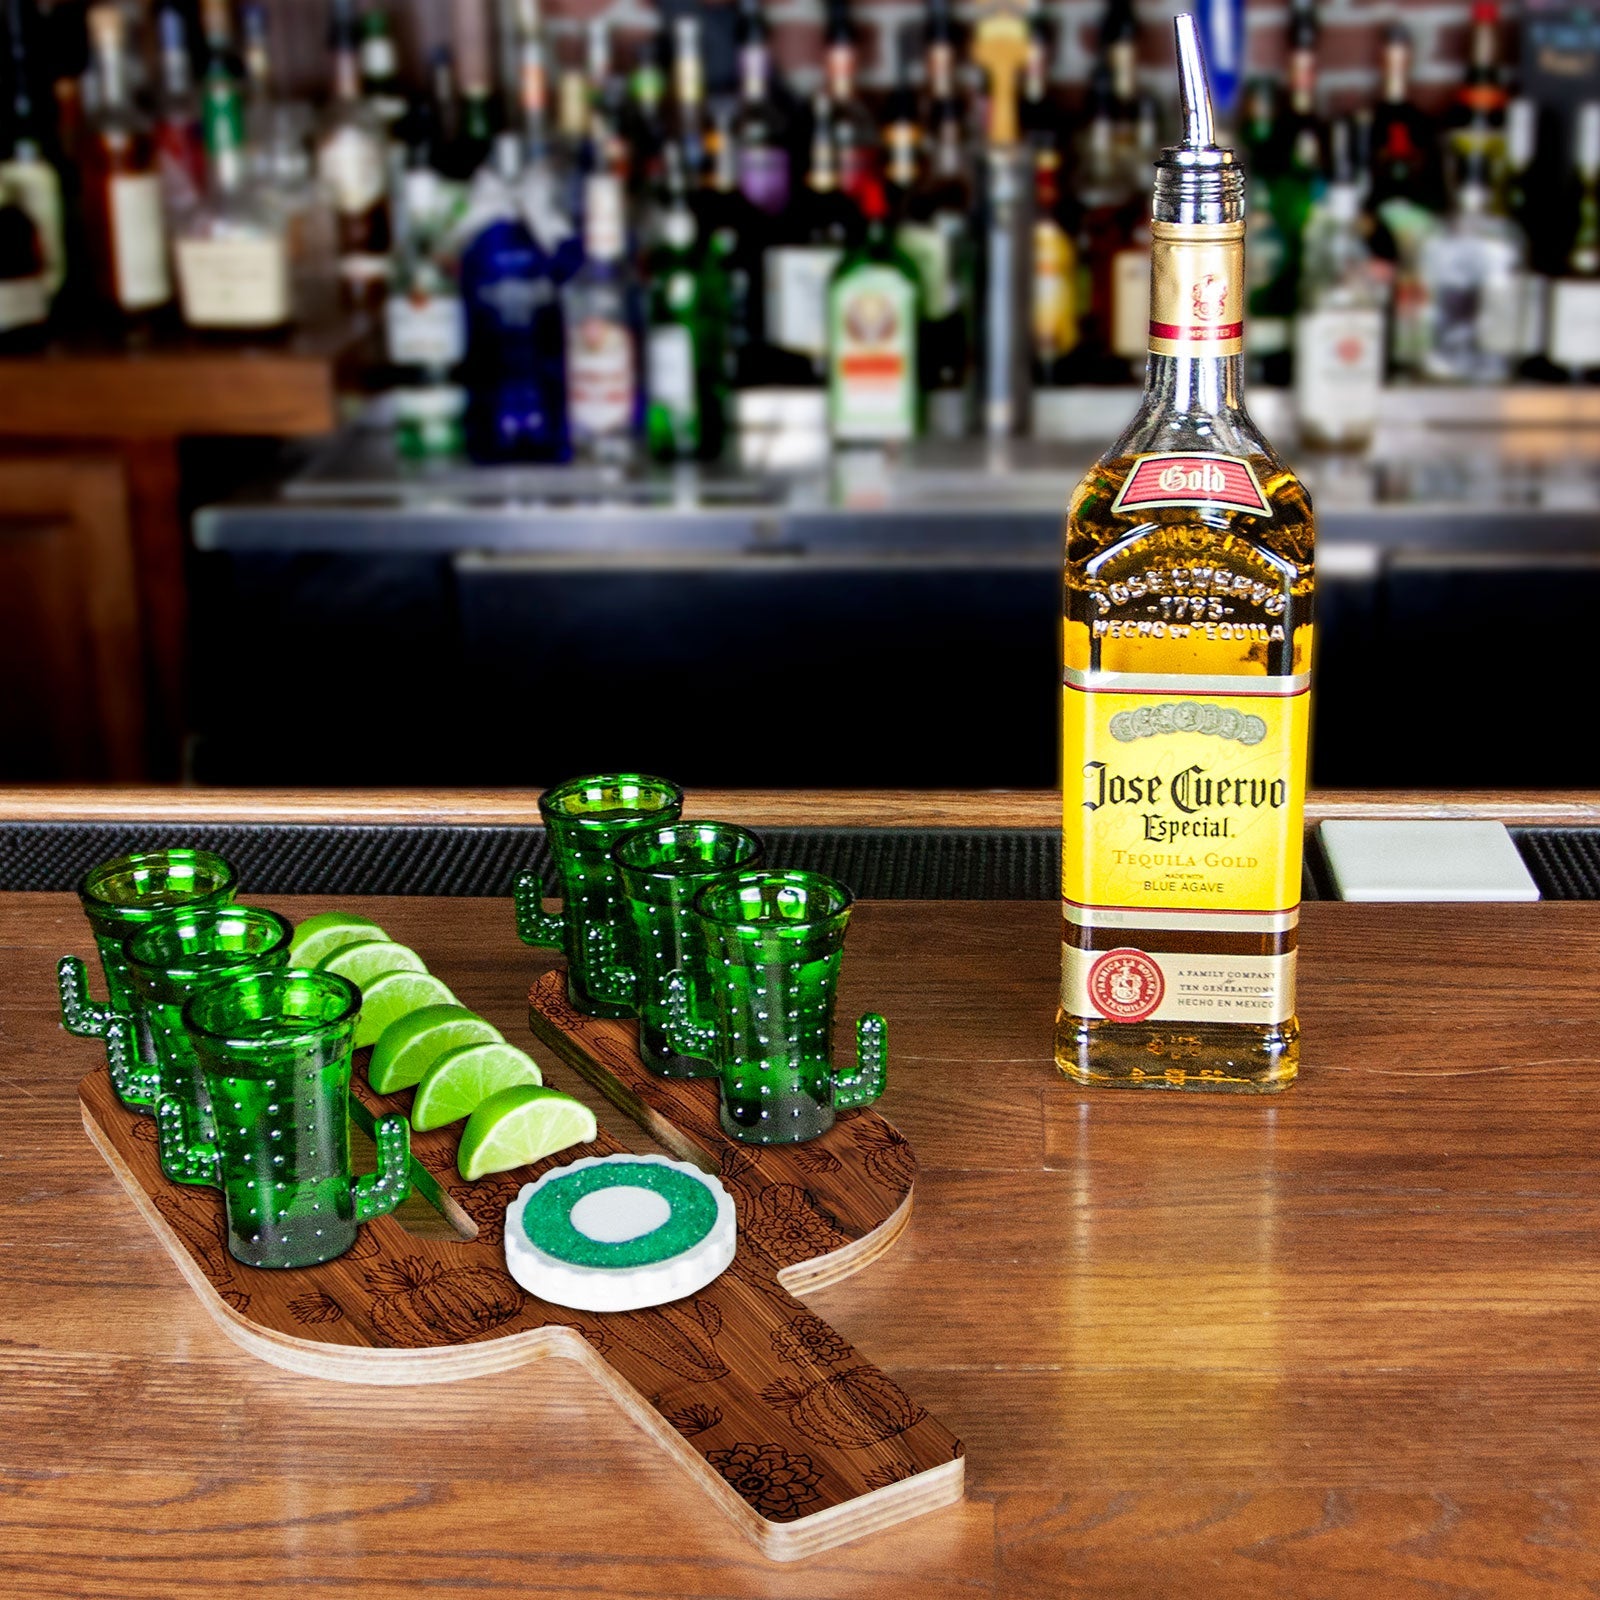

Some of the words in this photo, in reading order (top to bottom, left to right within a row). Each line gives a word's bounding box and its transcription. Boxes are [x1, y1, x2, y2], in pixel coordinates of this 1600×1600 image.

[1158, 463, 1226, 492] Gold
[1089, 570, 1166, 614] JOSE
[1092, 619, 1167, 639] HECHO
[1190, 621, 1285, 642] TEQUILA
[1081, 760, 1163, 812] Jose
[1171, 765, 1286, 814] Cuervo
[1112, 850, 1197, 869] TEQUILA
[1204, 852, 1259, 869] GOLD
[1143, 881, 1176, 892] BLUE
[1181, 882, 1225, 893] AGAVE
[1187, 970, 1225, 978] FAMILY
[1227, 971, 1275, 979] COMPANY
[1106, 998, 1146, 1014] TEQUILA
[1217, 999, 1231, 1007] EN
[1235, 1000, 1275, 1008] MEXICO
